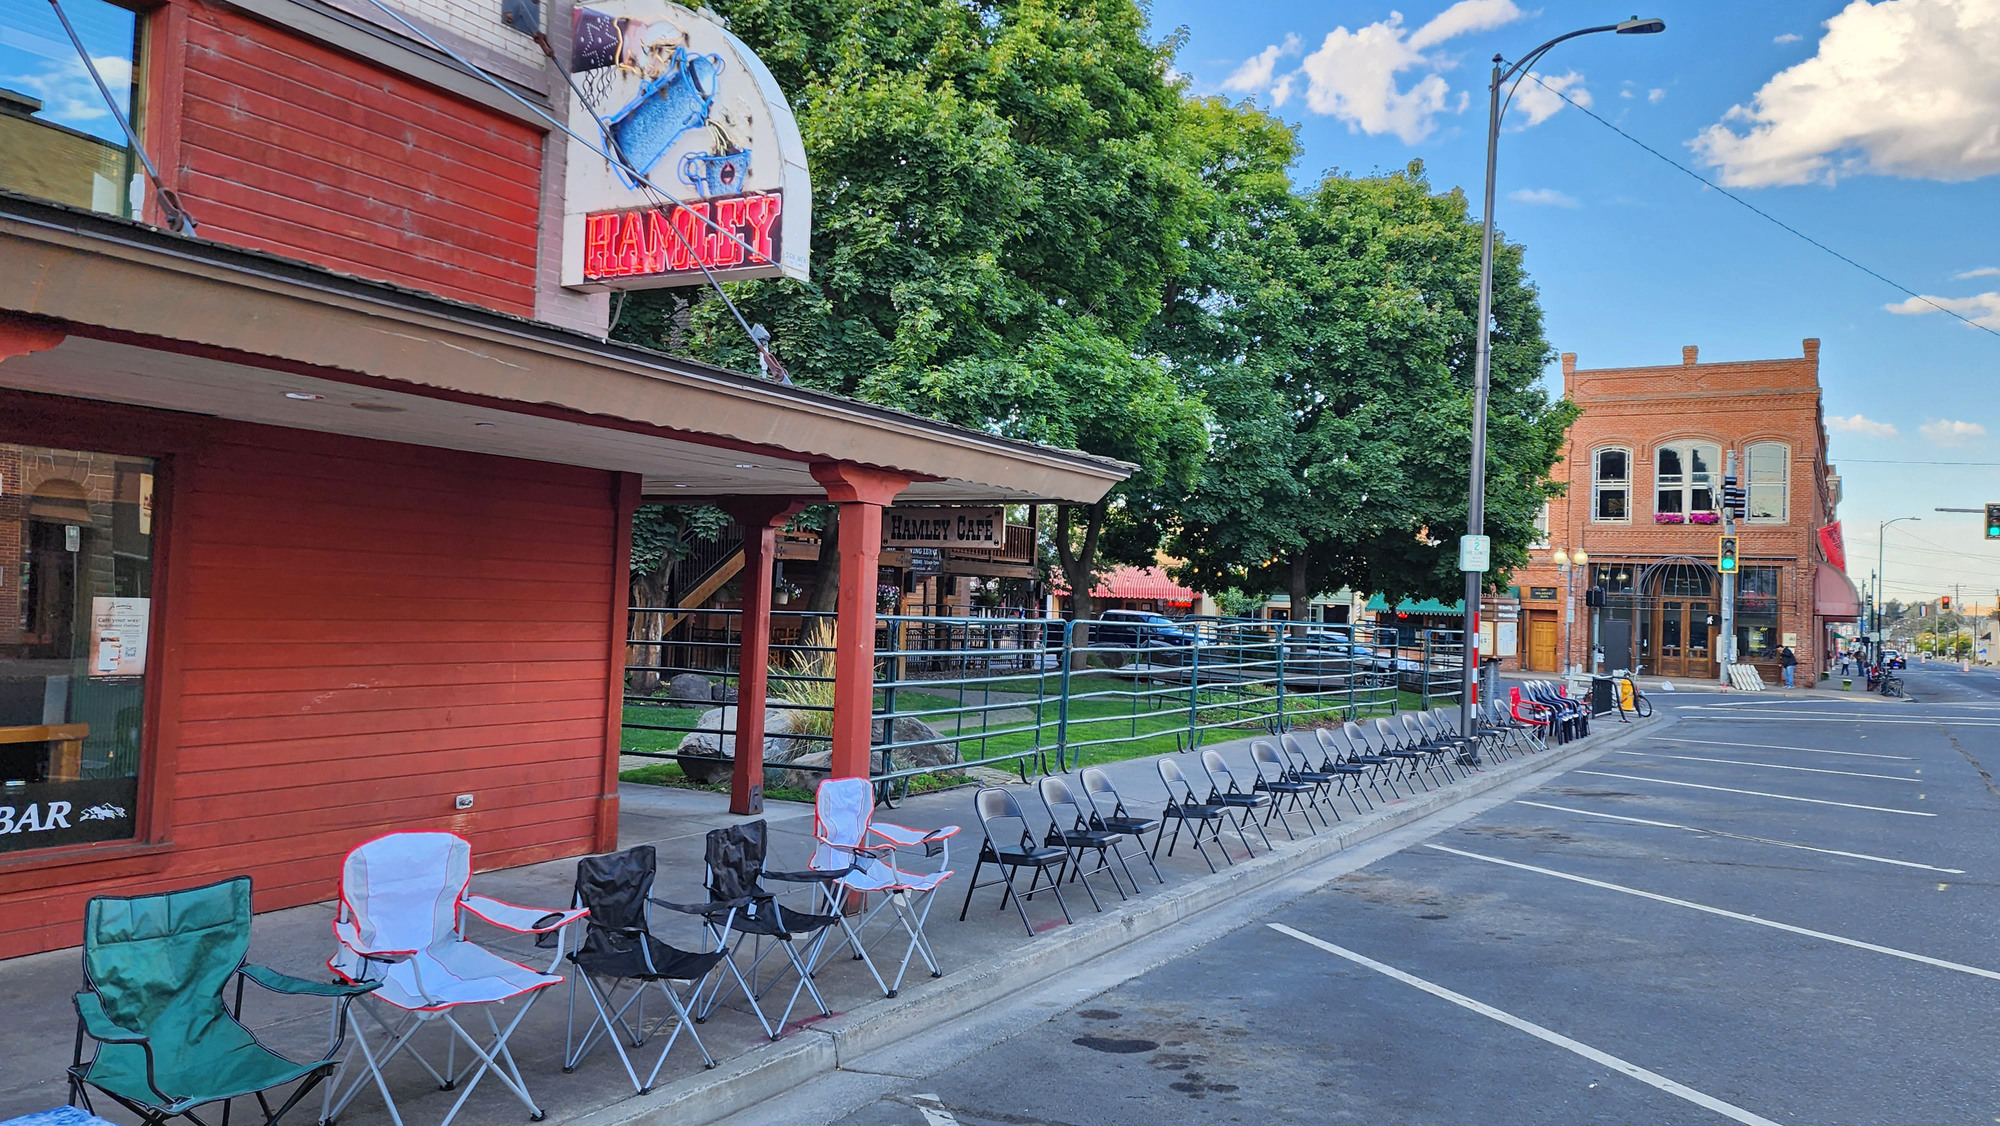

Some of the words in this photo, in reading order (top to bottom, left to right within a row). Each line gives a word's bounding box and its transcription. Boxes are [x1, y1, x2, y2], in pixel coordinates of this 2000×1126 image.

[584, 193, 781, 278] HAMLEY
[1474, 541, 1480, 551] 2
[0, 801, 72, 835] BAR
